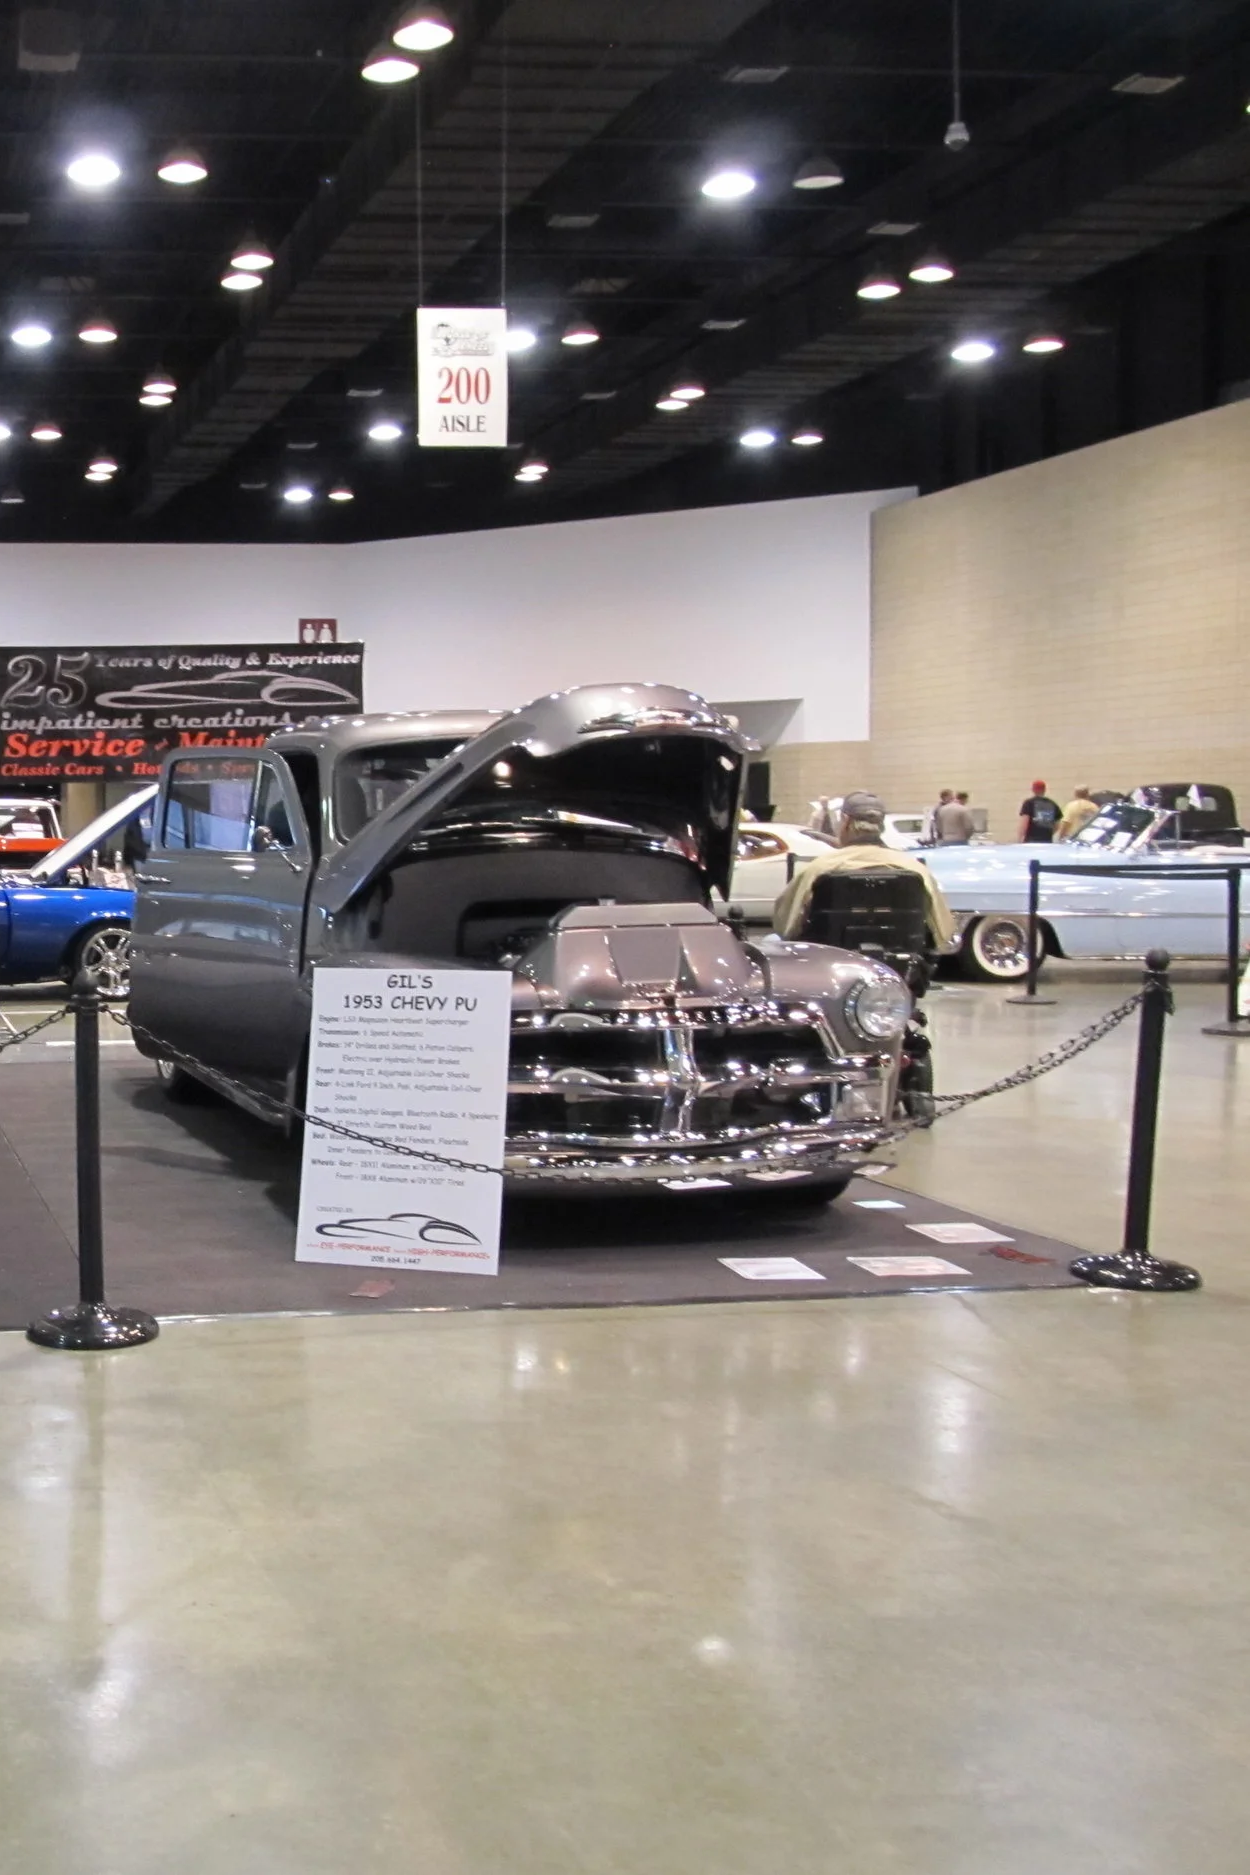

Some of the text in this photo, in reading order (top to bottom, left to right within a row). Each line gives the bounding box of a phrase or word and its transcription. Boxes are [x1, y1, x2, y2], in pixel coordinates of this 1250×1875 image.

[437, 367, 491, 405] 200
[439, 415, 487, 433] AISLE
[94, 652, 361, 670] Years of Quality & Experience
[0, 651, 90, 709] 25
[0, 711, 145, 735] impatient
[4, 731, 147, 759] Service
[1, 762, 70, 777] Classic
[73, 762, 105, 777] Cars
[386, 974, 433, 989] GIL'S
[343, 995, 478, 1012] 1953 CHEVY PU
